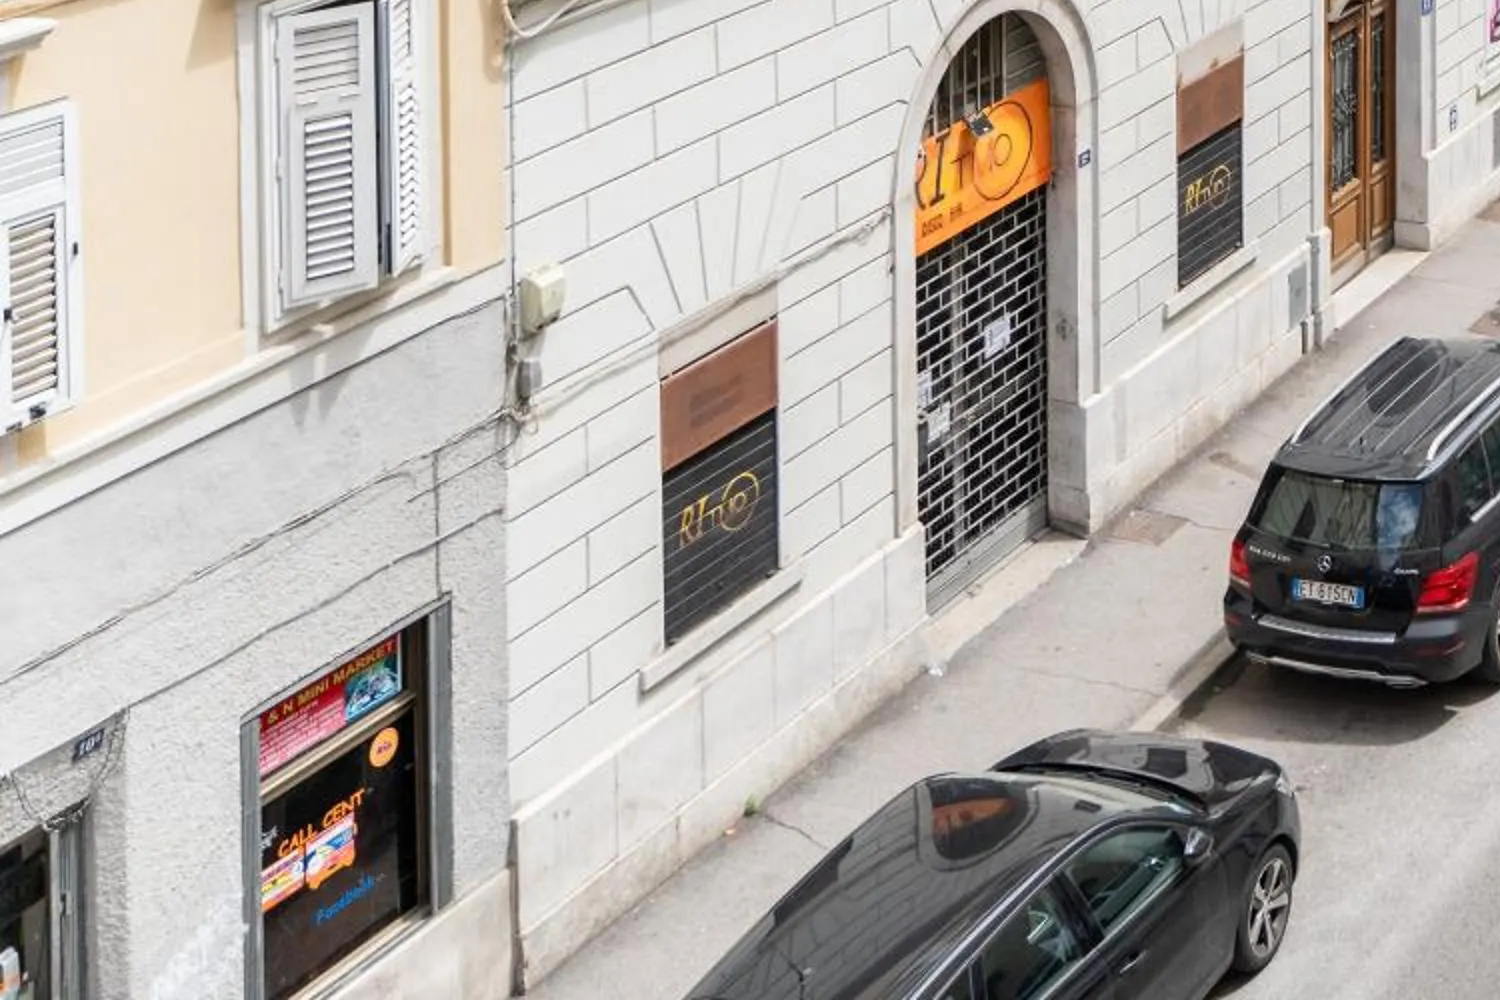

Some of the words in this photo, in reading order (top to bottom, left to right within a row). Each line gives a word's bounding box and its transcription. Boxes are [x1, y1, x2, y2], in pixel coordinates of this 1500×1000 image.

[297, 680, 329, 705] MINI
[333, 642, 394, 685] MARKET
[278, 824, 318, 858] CALL
